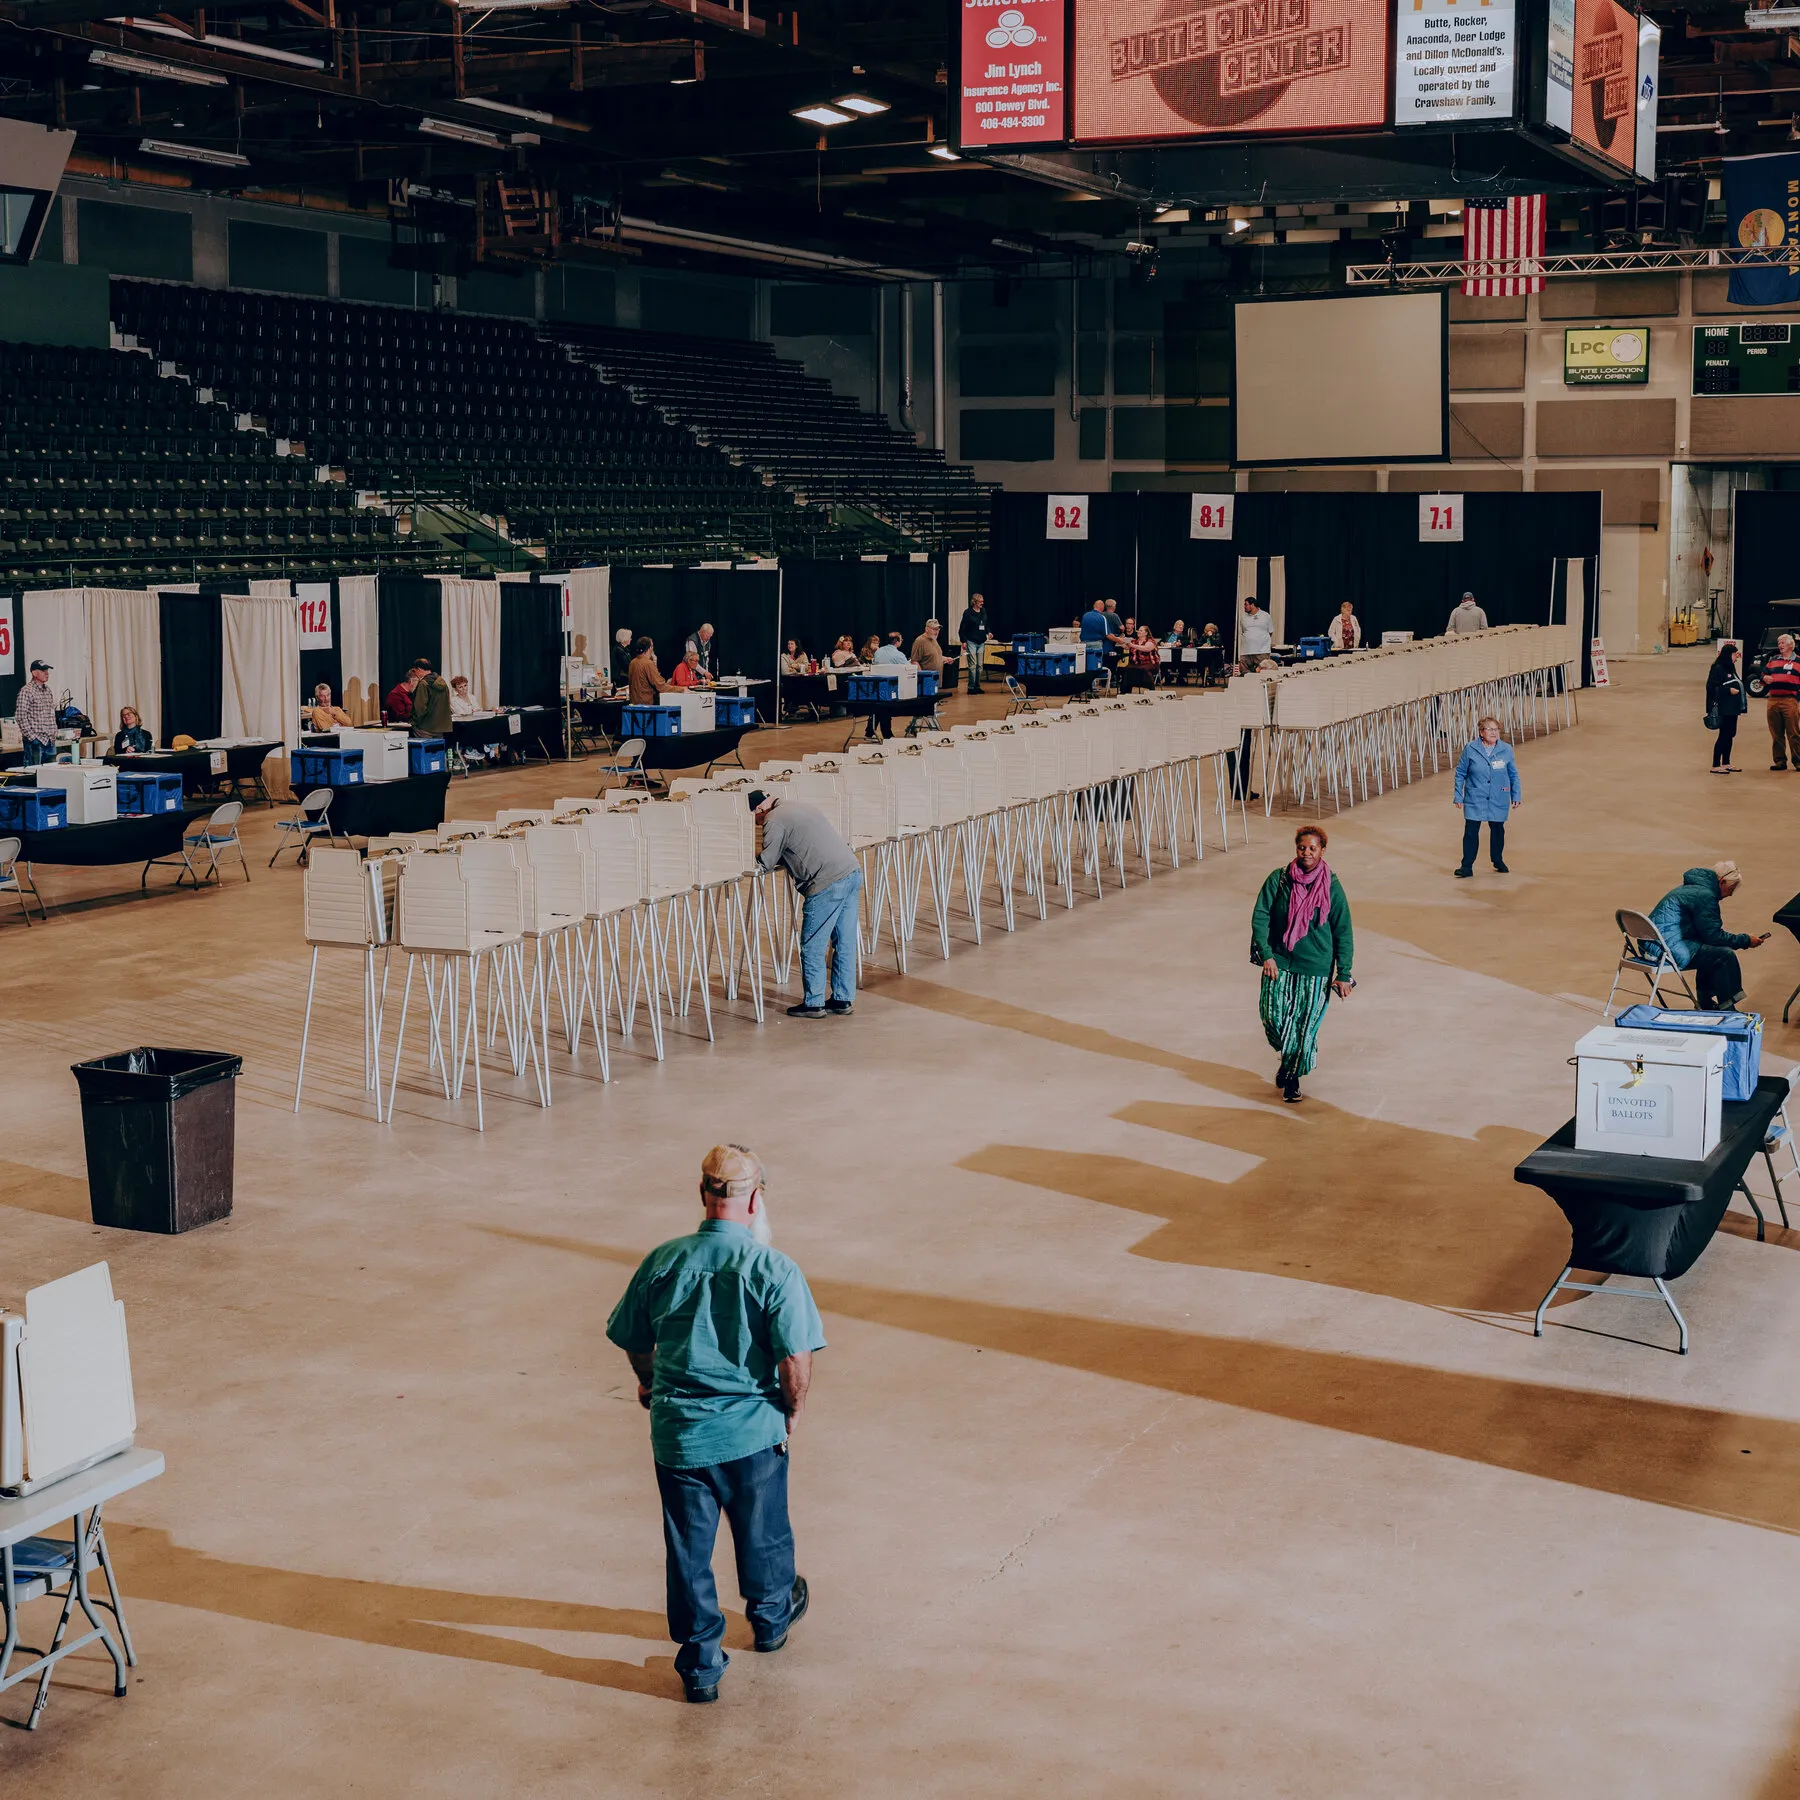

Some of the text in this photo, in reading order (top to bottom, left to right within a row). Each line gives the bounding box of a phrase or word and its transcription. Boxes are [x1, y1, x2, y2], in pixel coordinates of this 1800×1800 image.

[1424, 16, 1488, 28] Butte, Rocker,
[1111, 0, 1307, 75] BUTTE CIVIC
[1406, 31, 1505, 45] Anaconda, Deer Lodge
[1222, 27, 1345, 89] CENTER
[1406, 51, 1422, 60] and
[1425, 50, 1448, 59] Dillon
[984, 62, 1041, 78] Jim Lynch
[1414, 63, 1496, 76] Locally owned and
[963, 81, 1062, 97] Insurance Agency Inc.
[1418, 79, 1489, 92] operated by the
[995, 101, 1025, 112] Dewey
[1028, 98, 1050, 110] Blvd.
[1415, 95, 1496, 108] Crawshaw Family.
[1787, 180, 1799, 276] MONTANA
[1704, 328, 1729, 337] HOME
[1570, 342, 1605, 354] LPC
[1054, 506, 1080, 528] 8.2
[1200, 505, 1224, 528] 8.1
[1430, 507, 1452, 529] 7.1
[300, 600, 327, 633] 11.2
[1608, 1097, 1656, 1108] UNVOTED
[1611, 1110, 1653, 1120] BALLOTS
